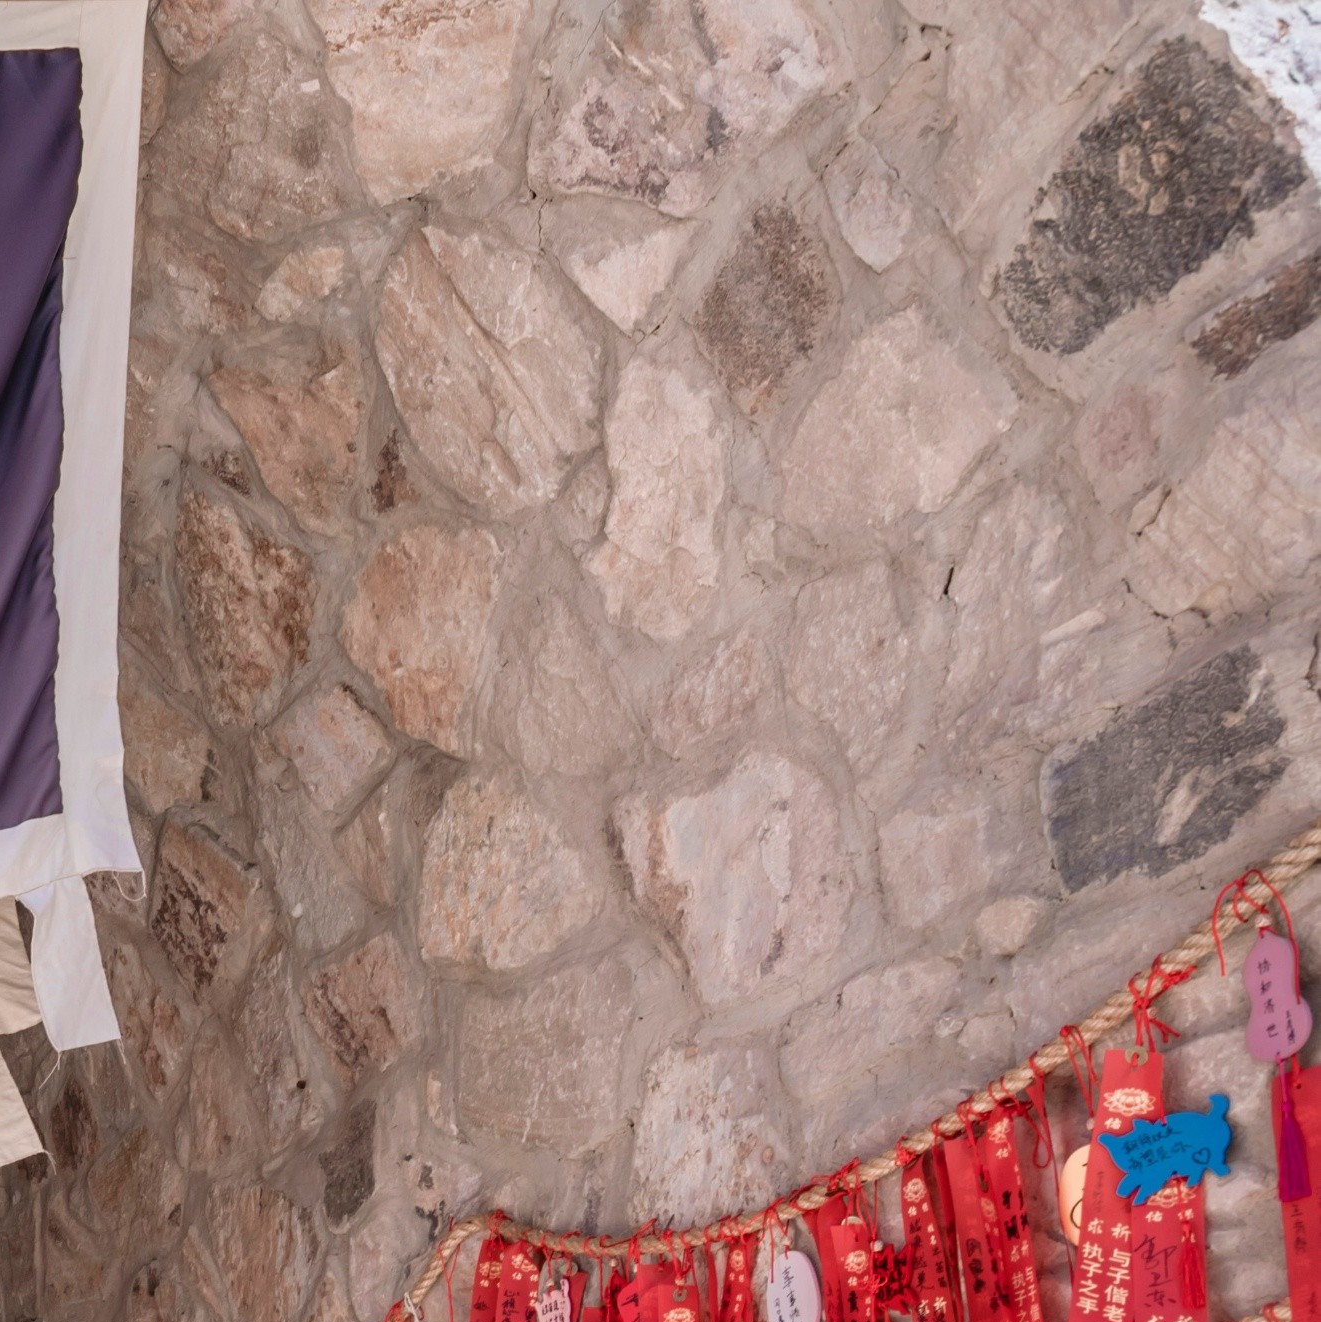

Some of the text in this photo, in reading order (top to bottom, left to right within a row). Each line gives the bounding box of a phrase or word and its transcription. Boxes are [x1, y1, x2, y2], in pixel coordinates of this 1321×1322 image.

[1075, 1242, 1104, 1315] 执子之手
[1102, 1248, 1133, 1322] 与子偕老
